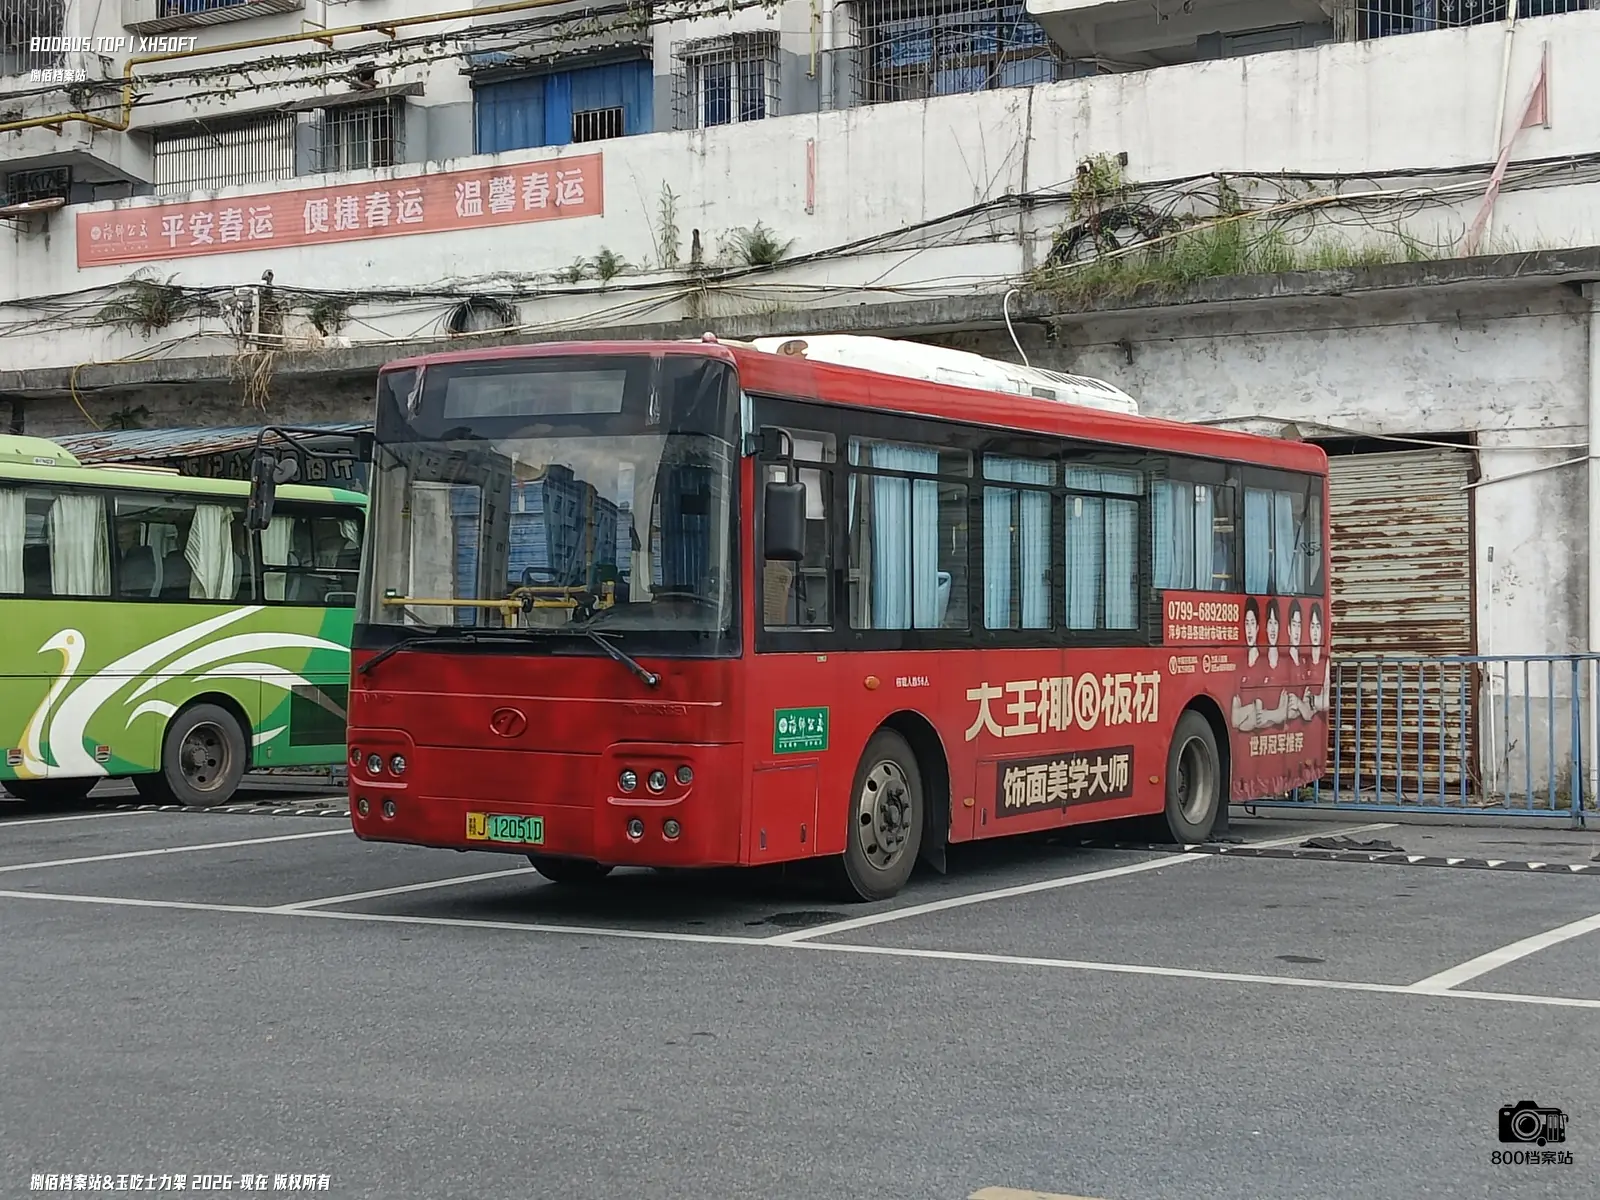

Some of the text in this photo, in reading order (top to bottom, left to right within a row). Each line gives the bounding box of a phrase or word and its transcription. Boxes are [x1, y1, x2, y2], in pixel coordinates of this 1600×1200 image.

[161, 168, 585, 247] 平安春运 便捷春运 温馨春运
[1168, 600, 1240, 622] 0799-6892888
[1249, 732, 1304, 757] 世界冠军推荐
[1002, 753, 1131, 809] 饰面美学大师
